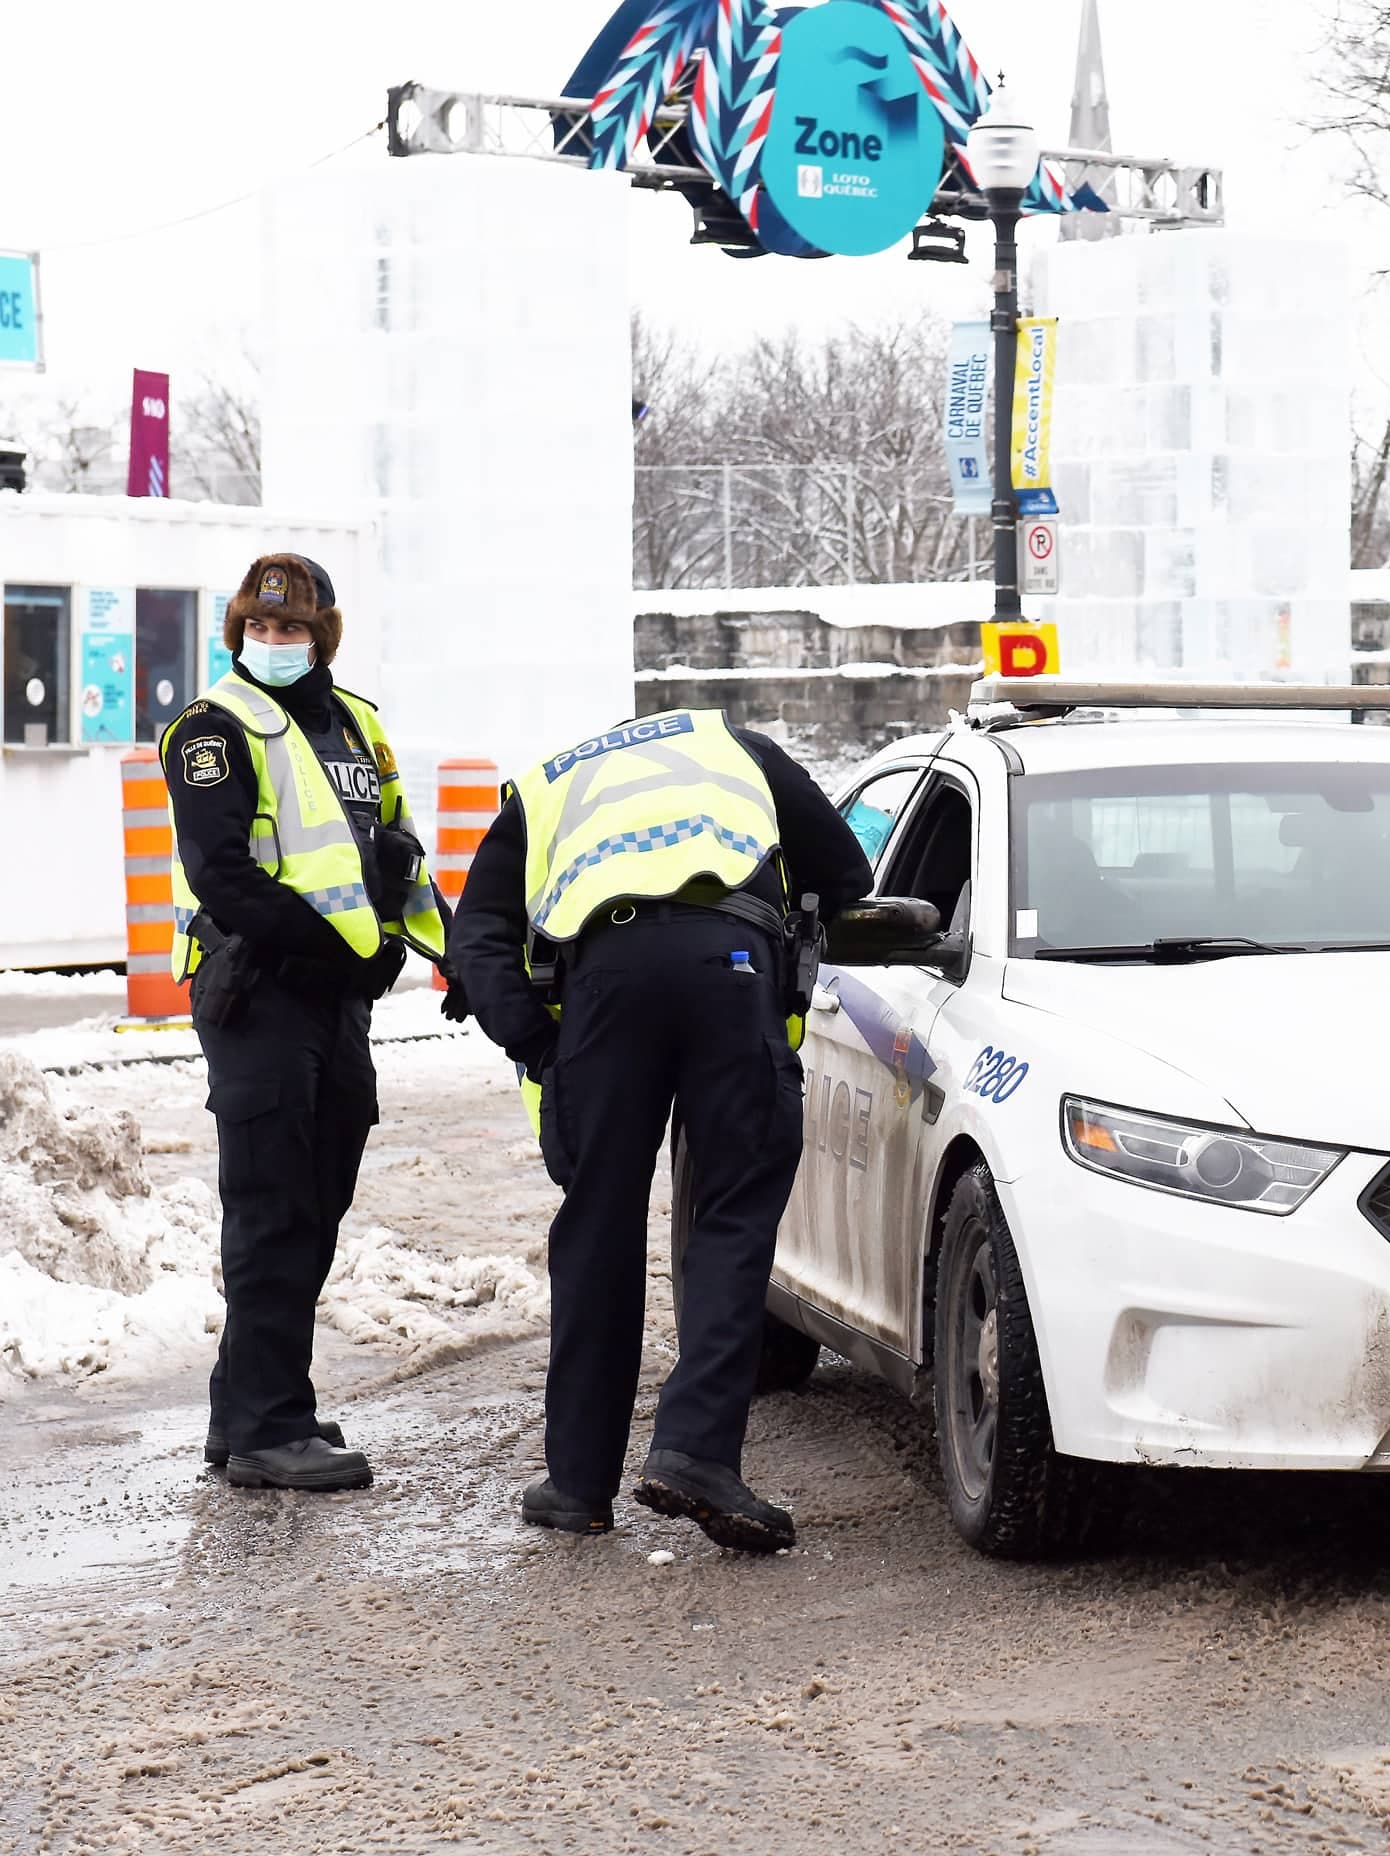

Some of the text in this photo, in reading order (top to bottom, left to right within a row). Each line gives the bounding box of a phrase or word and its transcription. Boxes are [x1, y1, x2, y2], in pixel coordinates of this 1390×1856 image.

[794, 116, 882, 161] Zone
[832, 173, 870, 186] LOTO
[948, 360, 970, 438] CARNAVAL
[1024, 328, 1043, 477] #AccentLocal
[965, 420, 981, 438] DE
[998, 634, 1048, 677] D
[553, 716, 682, 773] POLICE
[291, 741, 318, 811] POLICE
[333, 764, 380, 800] LICE
[963, 1045, 1029, 1103] 6280
[804, 1067, 873, 1172] LICE
